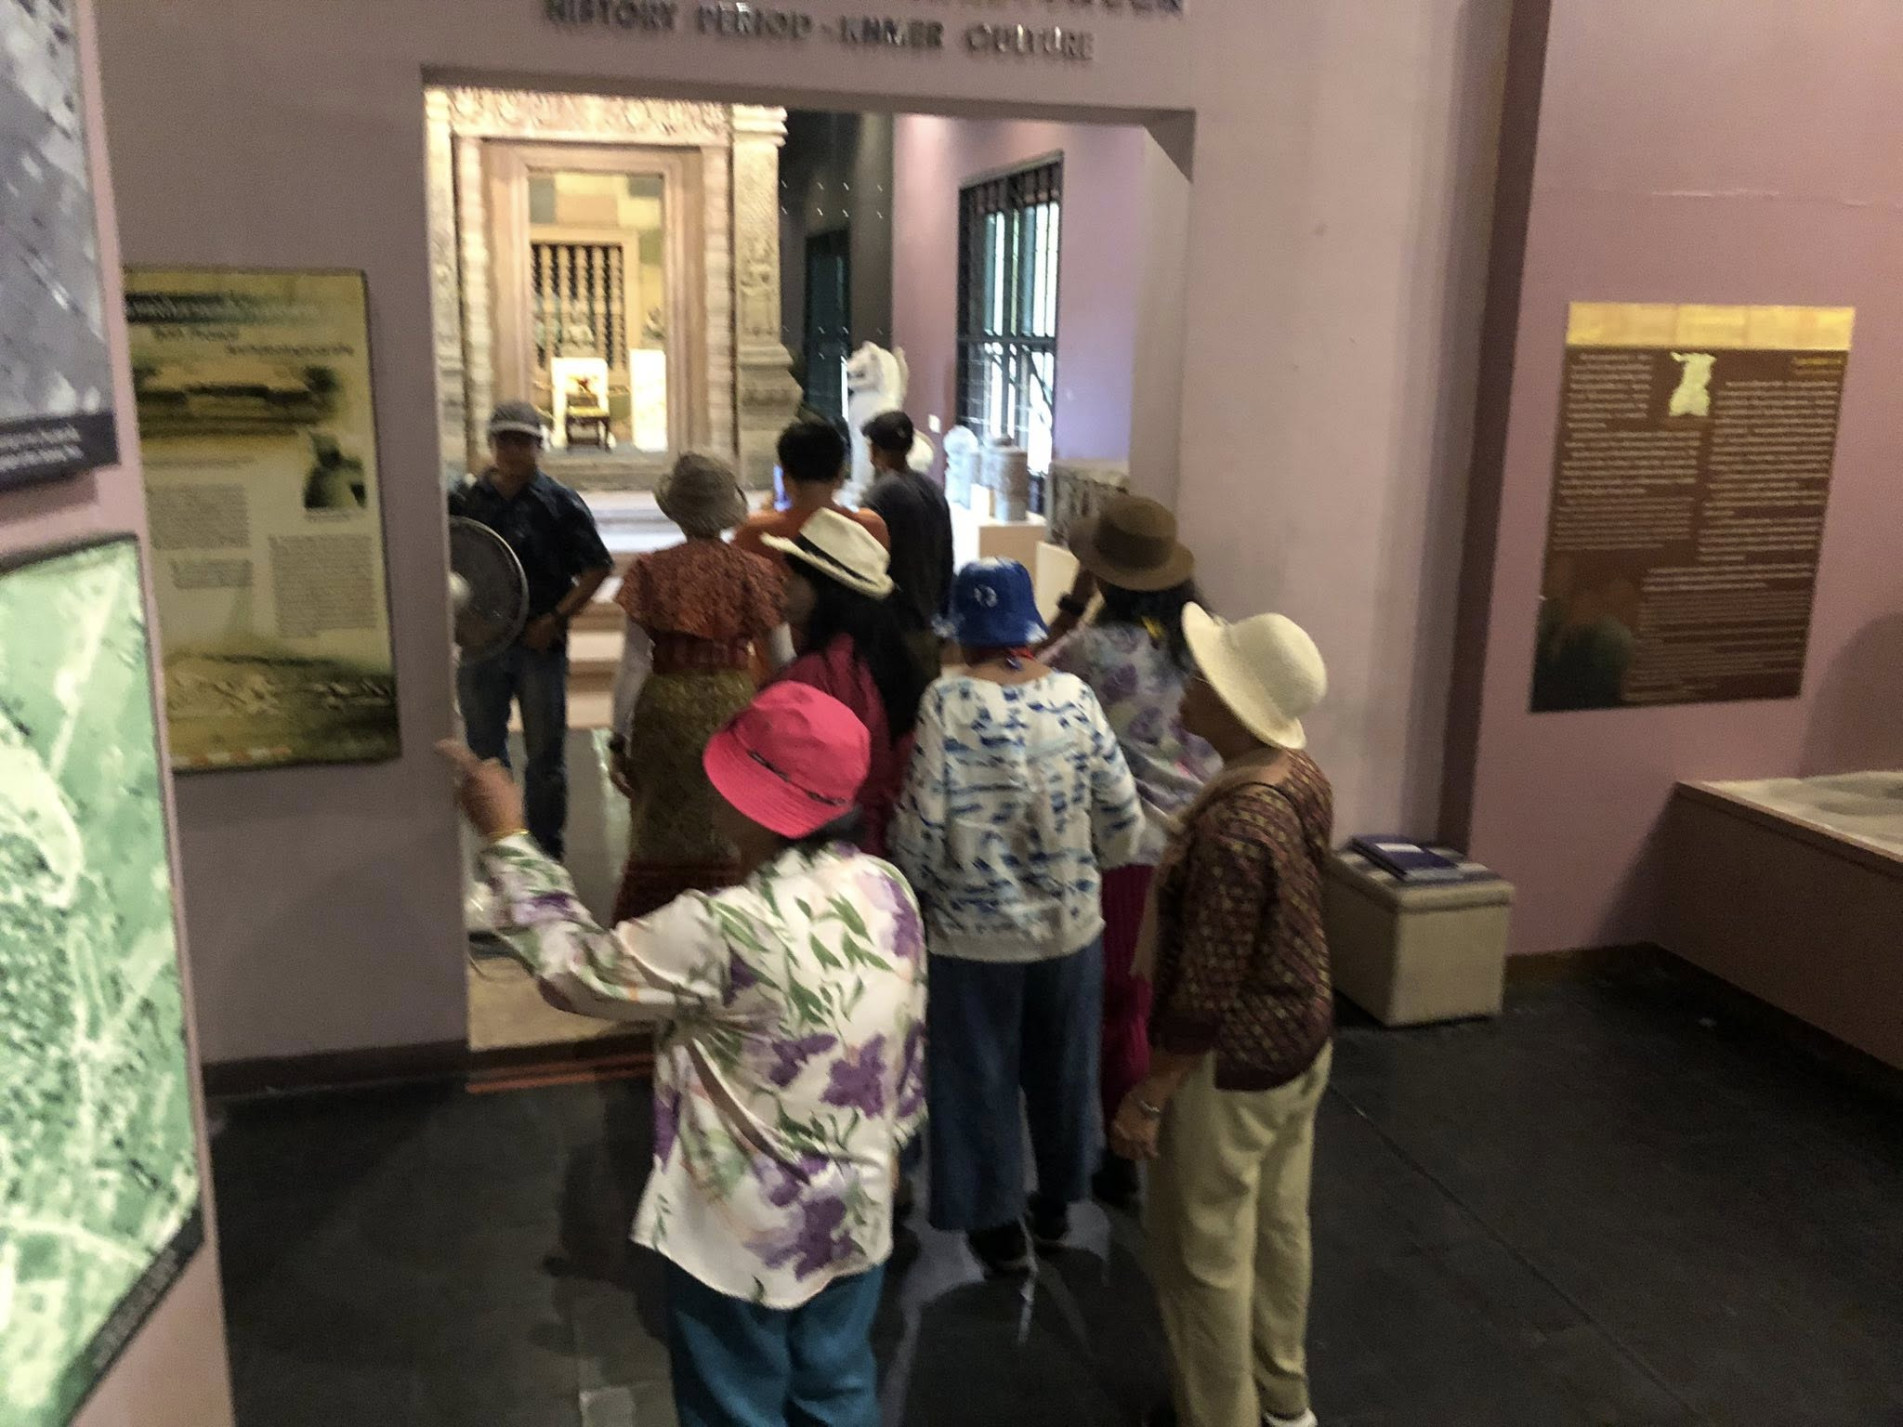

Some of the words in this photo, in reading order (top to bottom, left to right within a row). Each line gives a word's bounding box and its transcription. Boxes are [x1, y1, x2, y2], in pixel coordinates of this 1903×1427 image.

[698, 2, 811, 37] PERIOD
[840, 15, 944, 48] KHMER
[964, 24, 1094, 59] CULTURE
